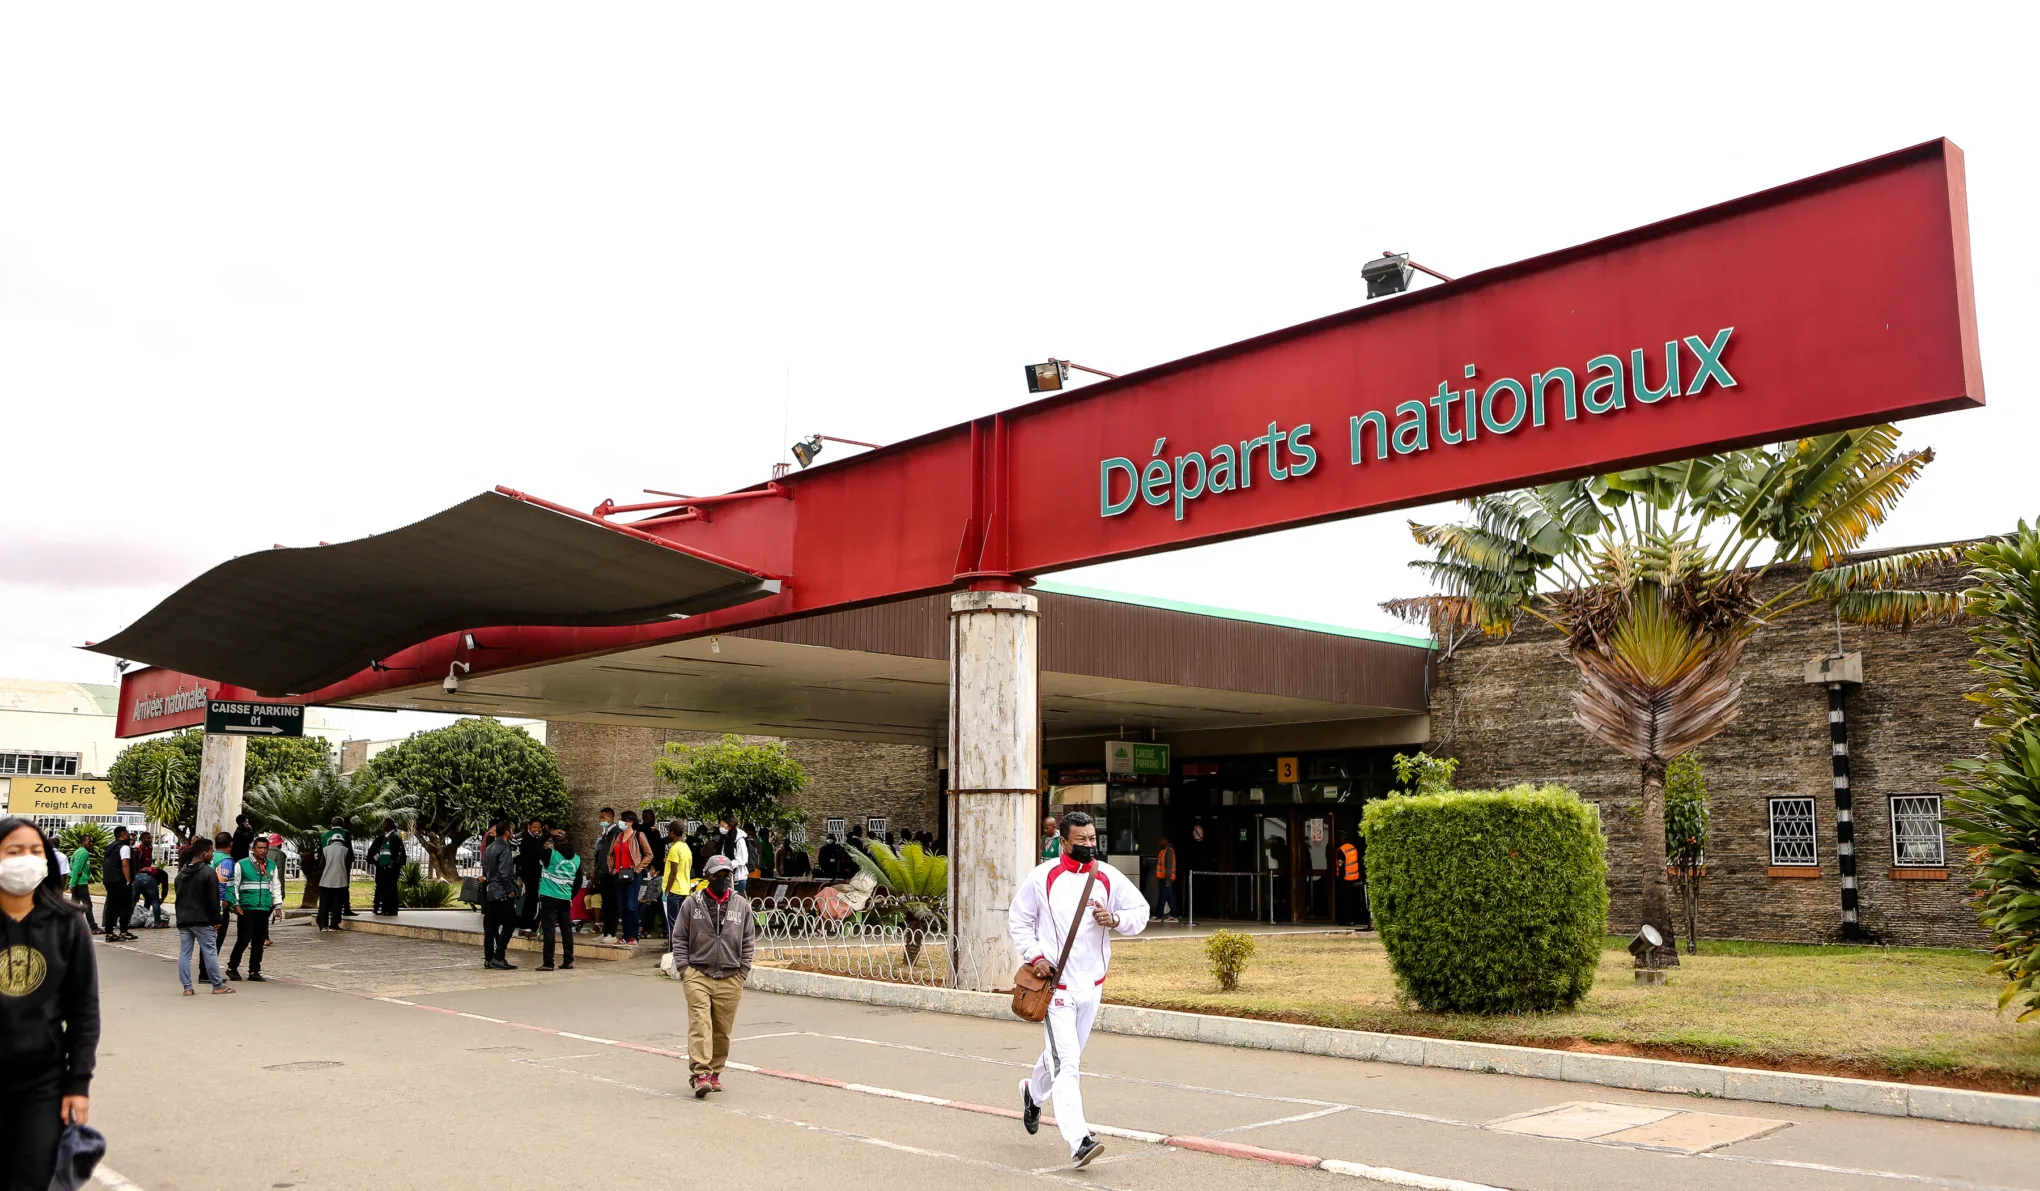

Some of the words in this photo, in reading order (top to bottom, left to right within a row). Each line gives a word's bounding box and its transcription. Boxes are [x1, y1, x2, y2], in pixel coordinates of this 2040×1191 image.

[1099, 420, 1318, 521] Départs
[1349, 326, 1738, 466] nationaux
[132, 691, 163, 722] Arrivées
[163, 681, 207, 716] nationales
[211, 702, 250, 714] CAISSE
[253, 705, 300, 717] PARKING
[250, 716, 262, 726] 01
[1135, 748, 1155, 759] CAISSE
[1161, 750, 1166, 769] 1
[1135, 759, 1160, 770] PARKING
[1283, 763, 1292, 778] 3
[34, 783, 67, 794] Zone
[71, 784, 96, 795] Fret
[34, 800, 69, 811] Freight
[71, 802, 93, 810] Area
